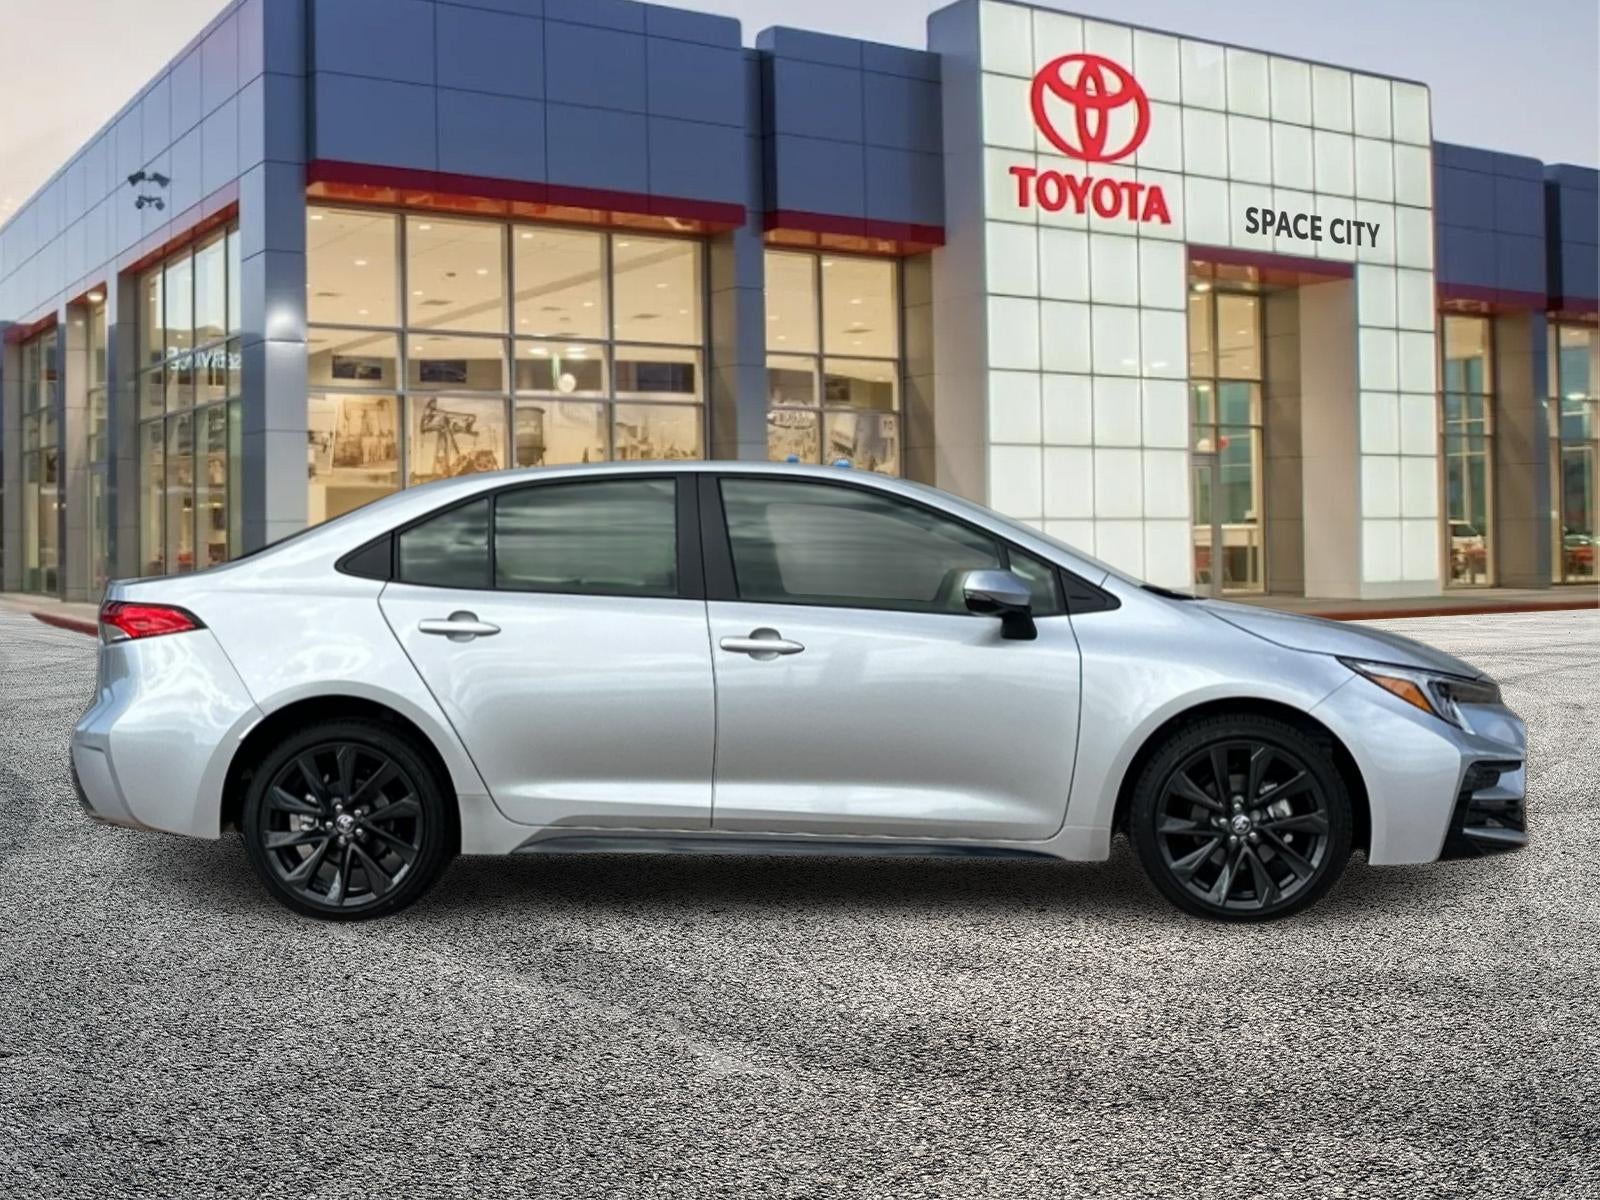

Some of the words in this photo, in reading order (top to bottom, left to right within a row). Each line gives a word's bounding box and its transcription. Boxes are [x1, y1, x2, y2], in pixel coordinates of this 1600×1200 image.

[1009, 166, 1171, 224] TOYOTA
[1245, 207, 1323, 242] SPACE
[1329, 218, 1381, 248] CITY
